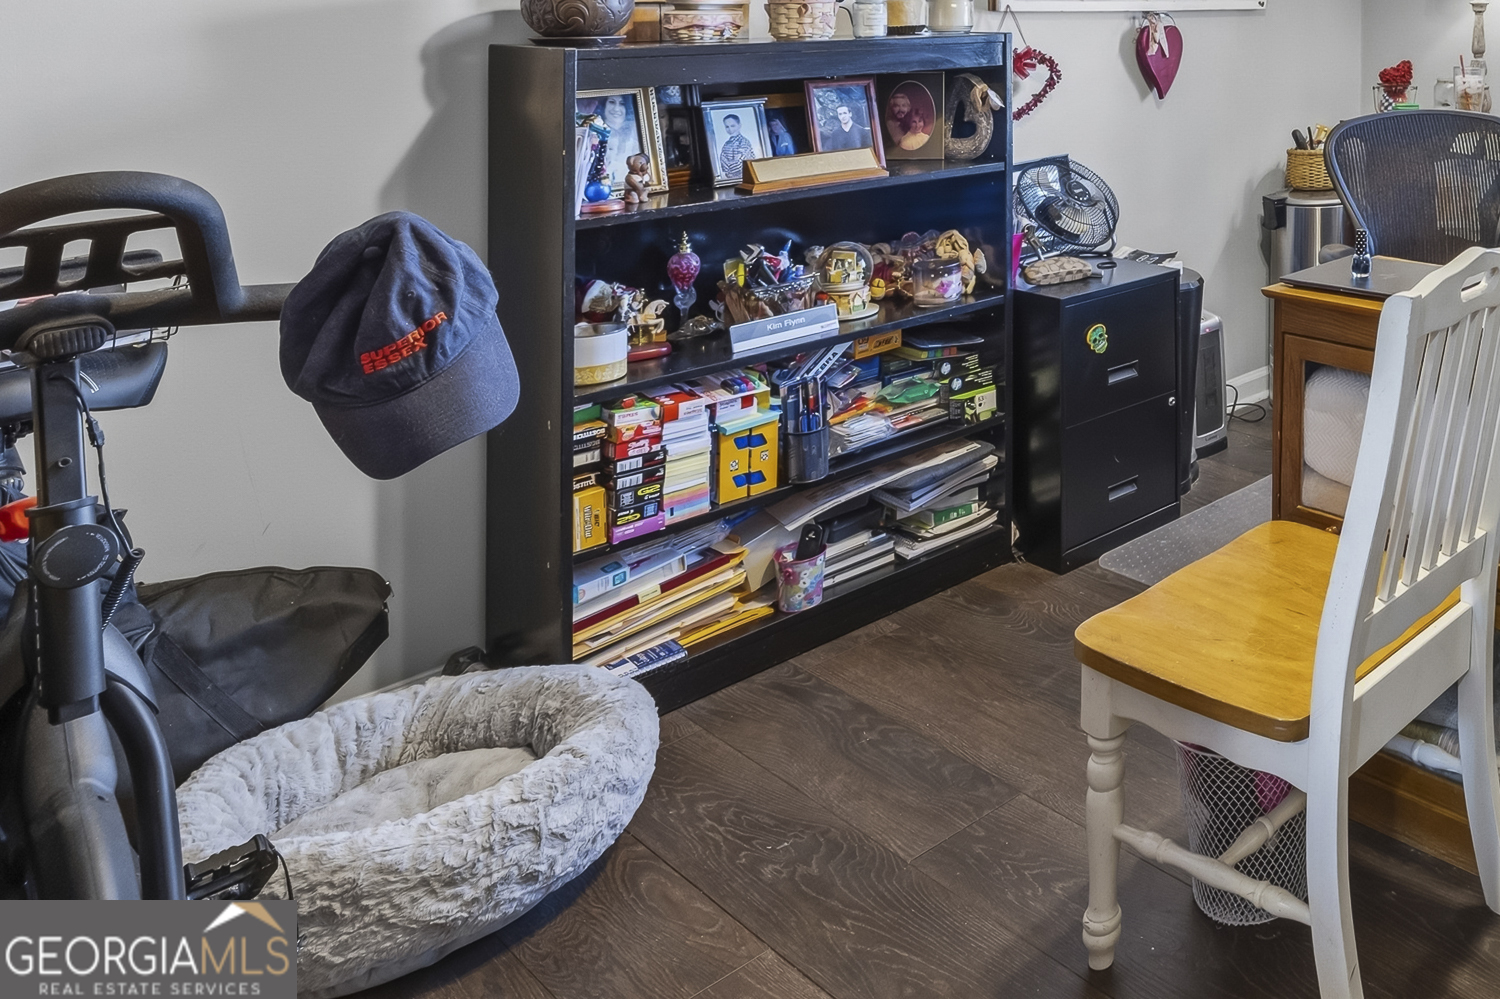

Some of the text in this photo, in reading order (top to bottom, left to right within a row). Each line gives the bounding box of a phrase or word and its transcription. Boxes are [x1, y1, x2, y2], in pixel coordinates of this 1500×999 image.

[360, 311, 447, 365] SUPERIOR
[766, 316, 806, 331] Kim Flynn
[363, 337, 428, 375] ESSEX
